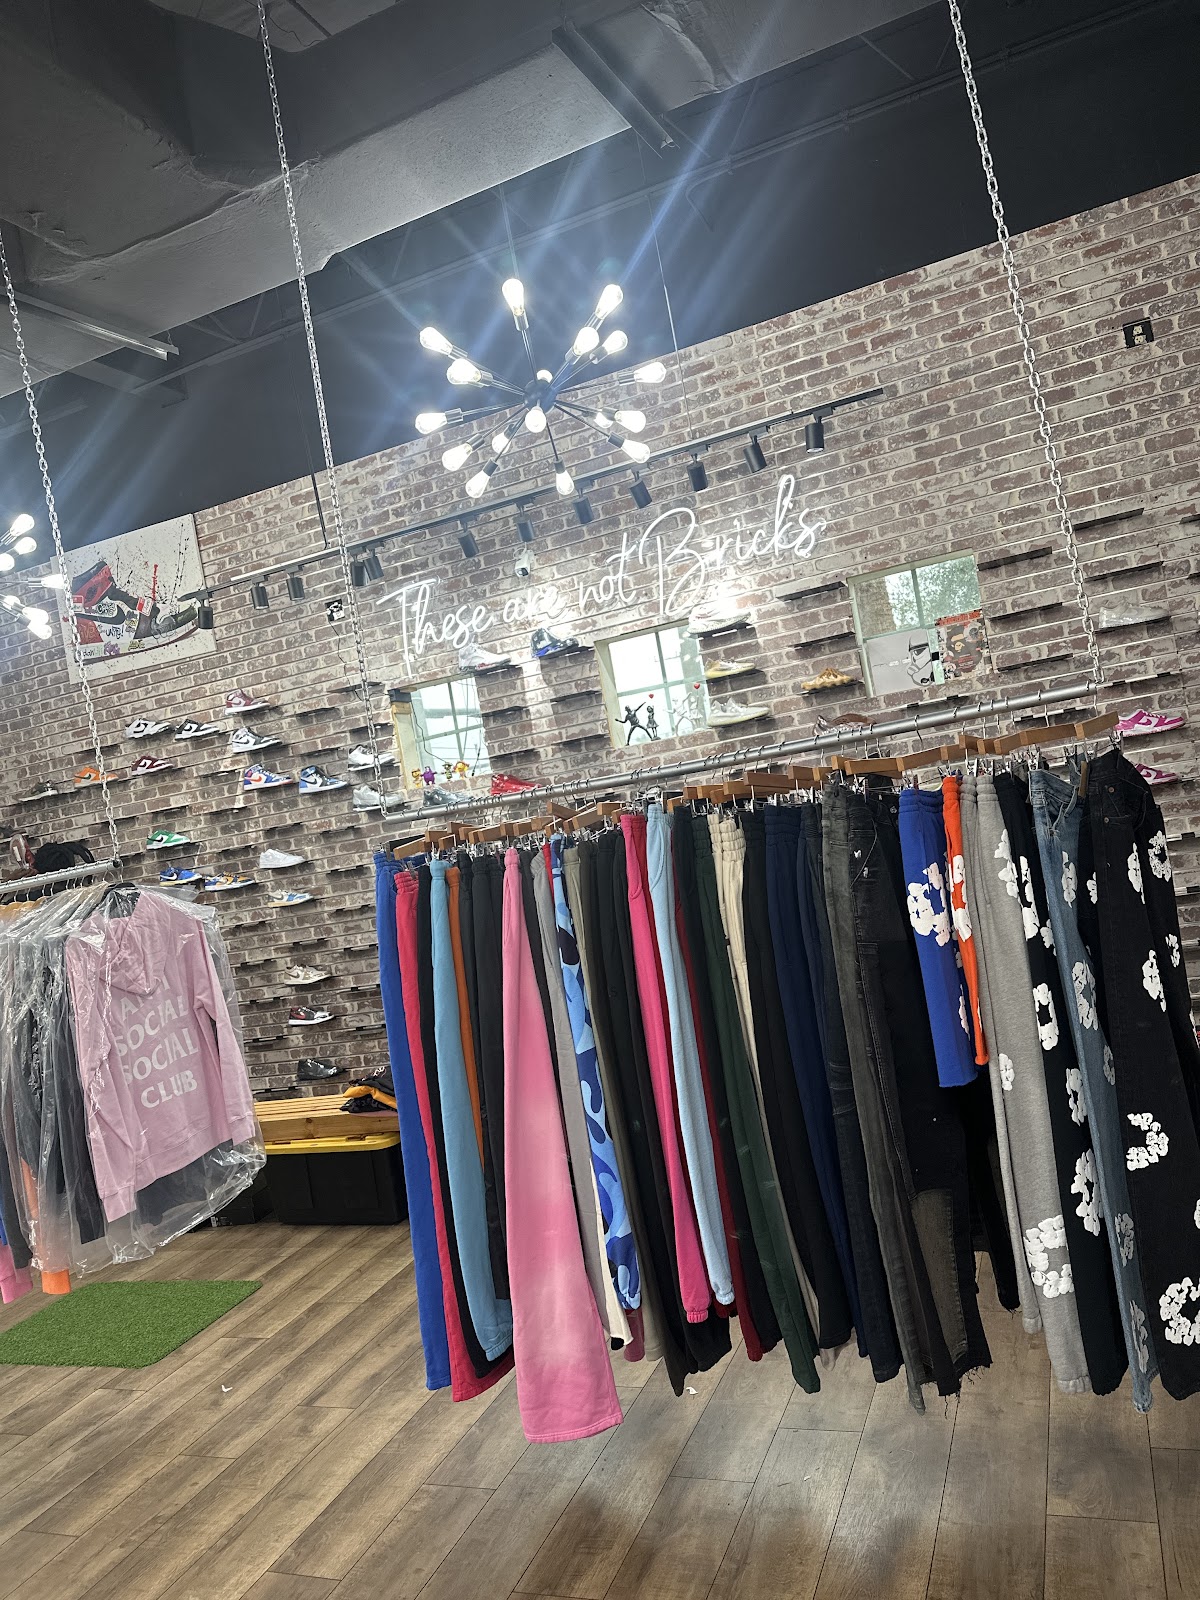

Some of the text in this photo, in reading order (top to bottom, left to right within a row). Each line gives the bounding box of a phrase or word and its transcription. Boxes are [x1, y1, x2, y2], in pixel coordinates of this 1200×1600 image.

[377, 474, 827, 678] These are not Bricks
[114, 995, 189, 1057] SOCIAL
[122, 1027, 199, 1085] SOCIAL
[140, 1069, 199, 1109] CLUB
